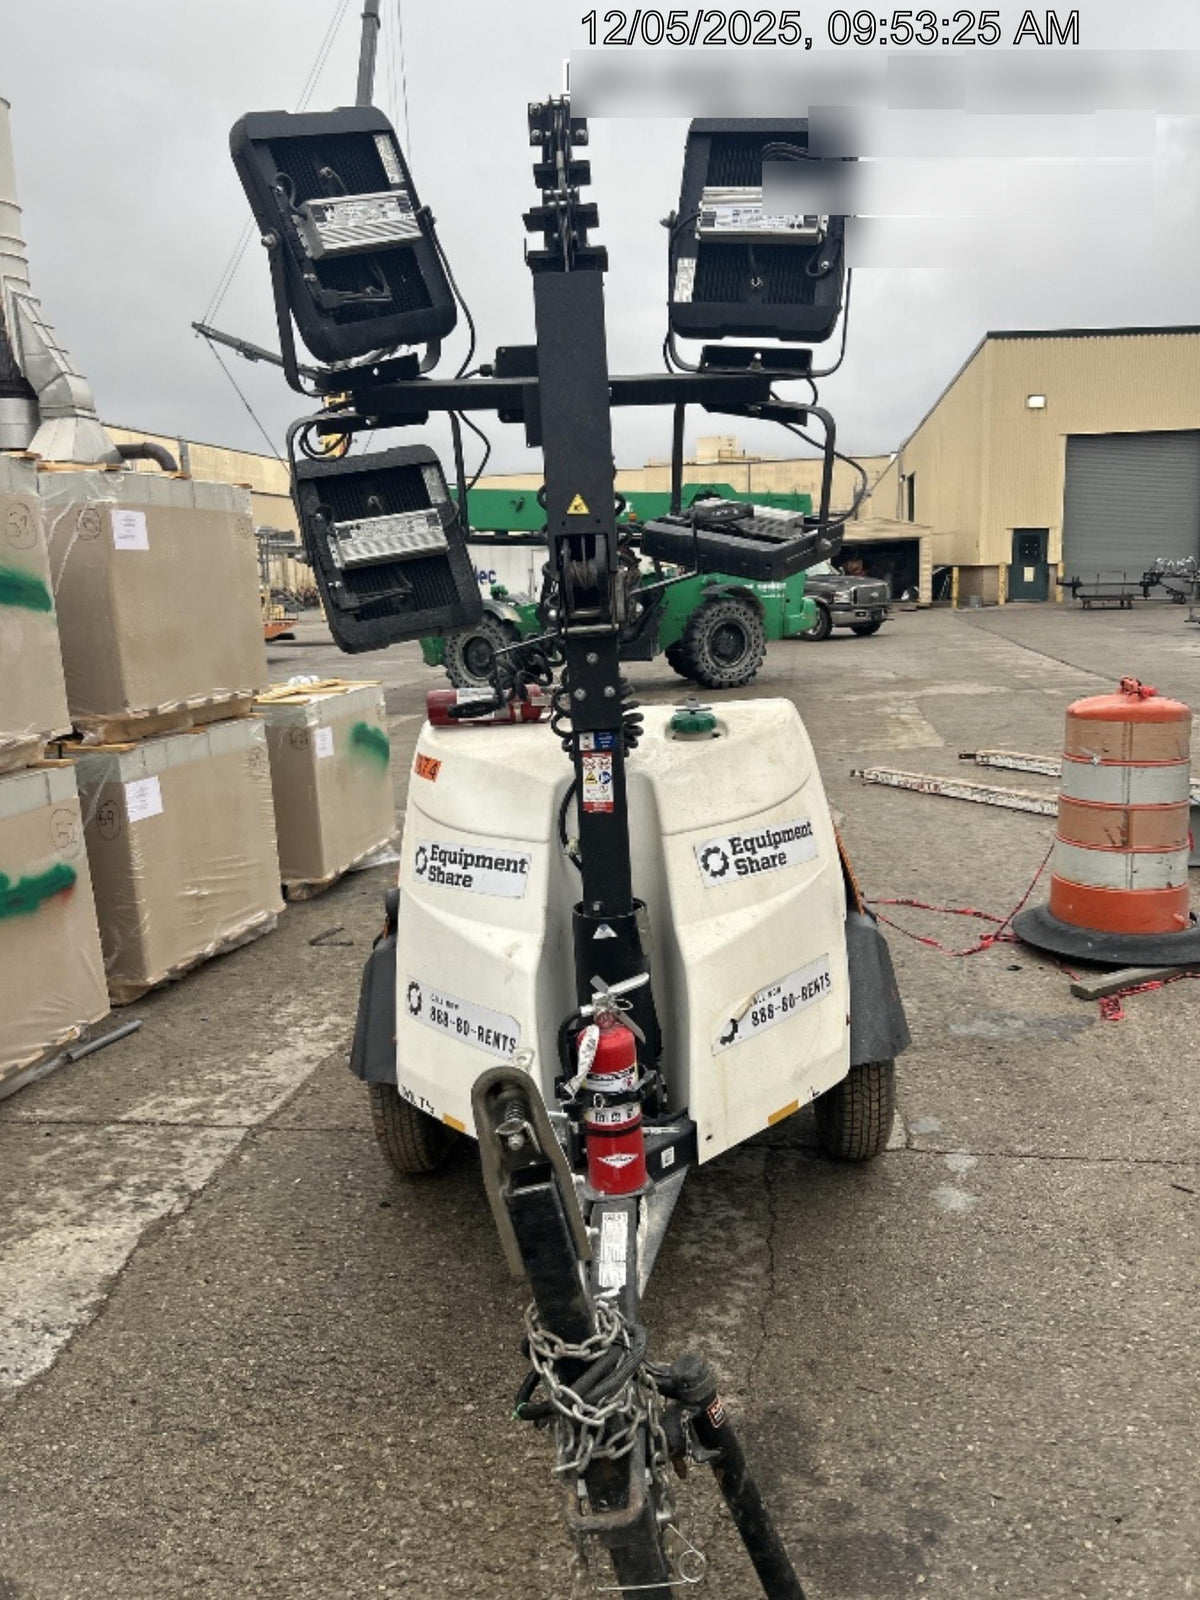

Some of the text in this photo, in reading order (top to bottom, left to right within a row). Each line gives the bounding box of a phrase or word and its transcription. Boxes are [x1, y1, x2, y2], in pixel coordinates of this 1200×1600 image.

[729, 821, 813, 855] Equipment
[430, 844, 529, 874] Equipment
[734, 851, 787, 876] Share
[427, 865, 473, 888] Share
